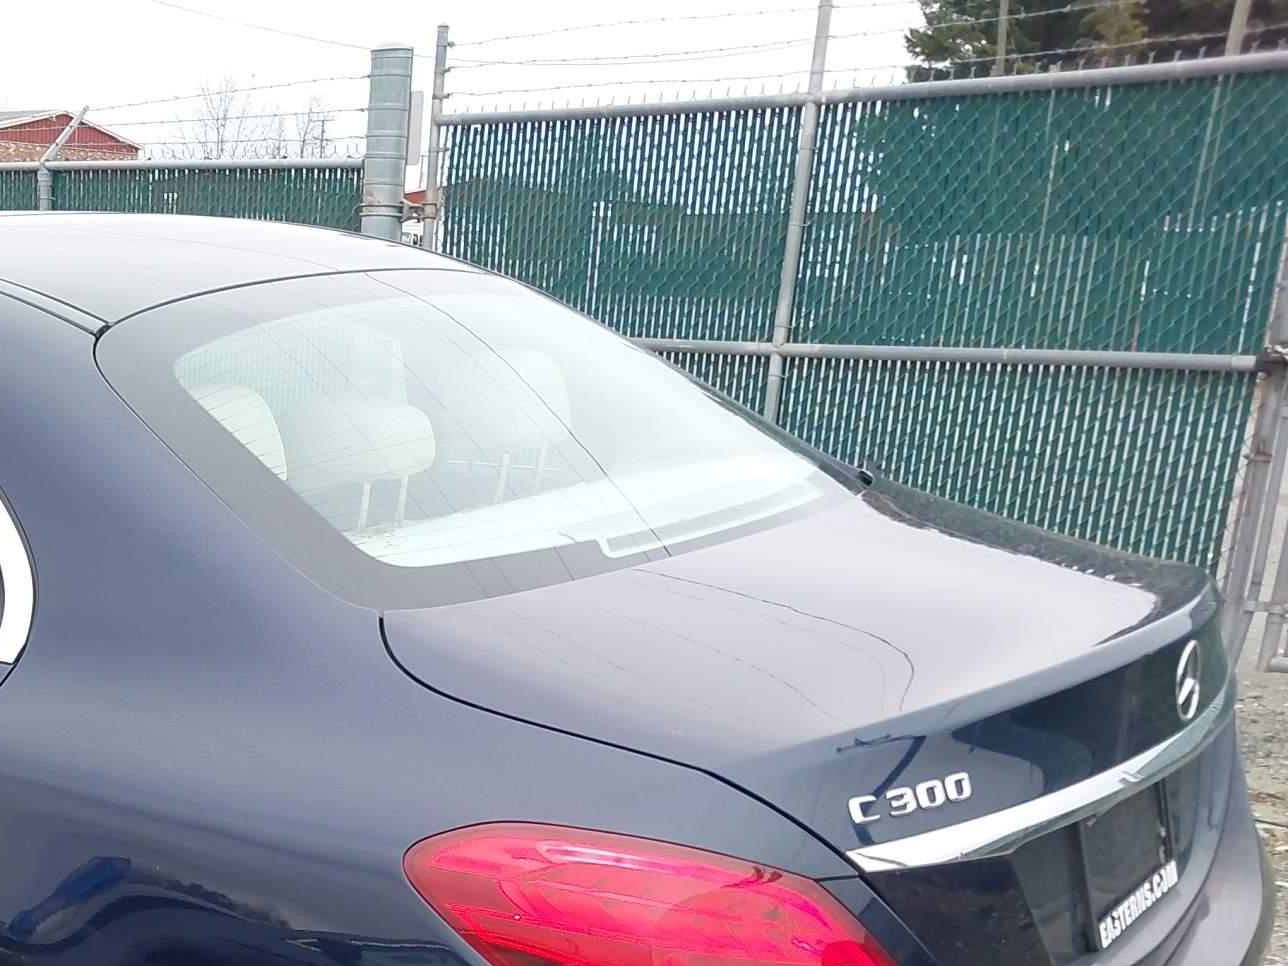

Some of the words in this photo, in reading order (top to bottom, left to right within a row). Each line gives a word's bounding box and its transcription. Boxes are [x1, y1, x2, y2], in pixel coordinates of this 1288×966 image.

[848, 795, 881, 824] C
[885, 771, 972, 816] 300
[1099, 860, 1178, 949] EASTERNS.COM
